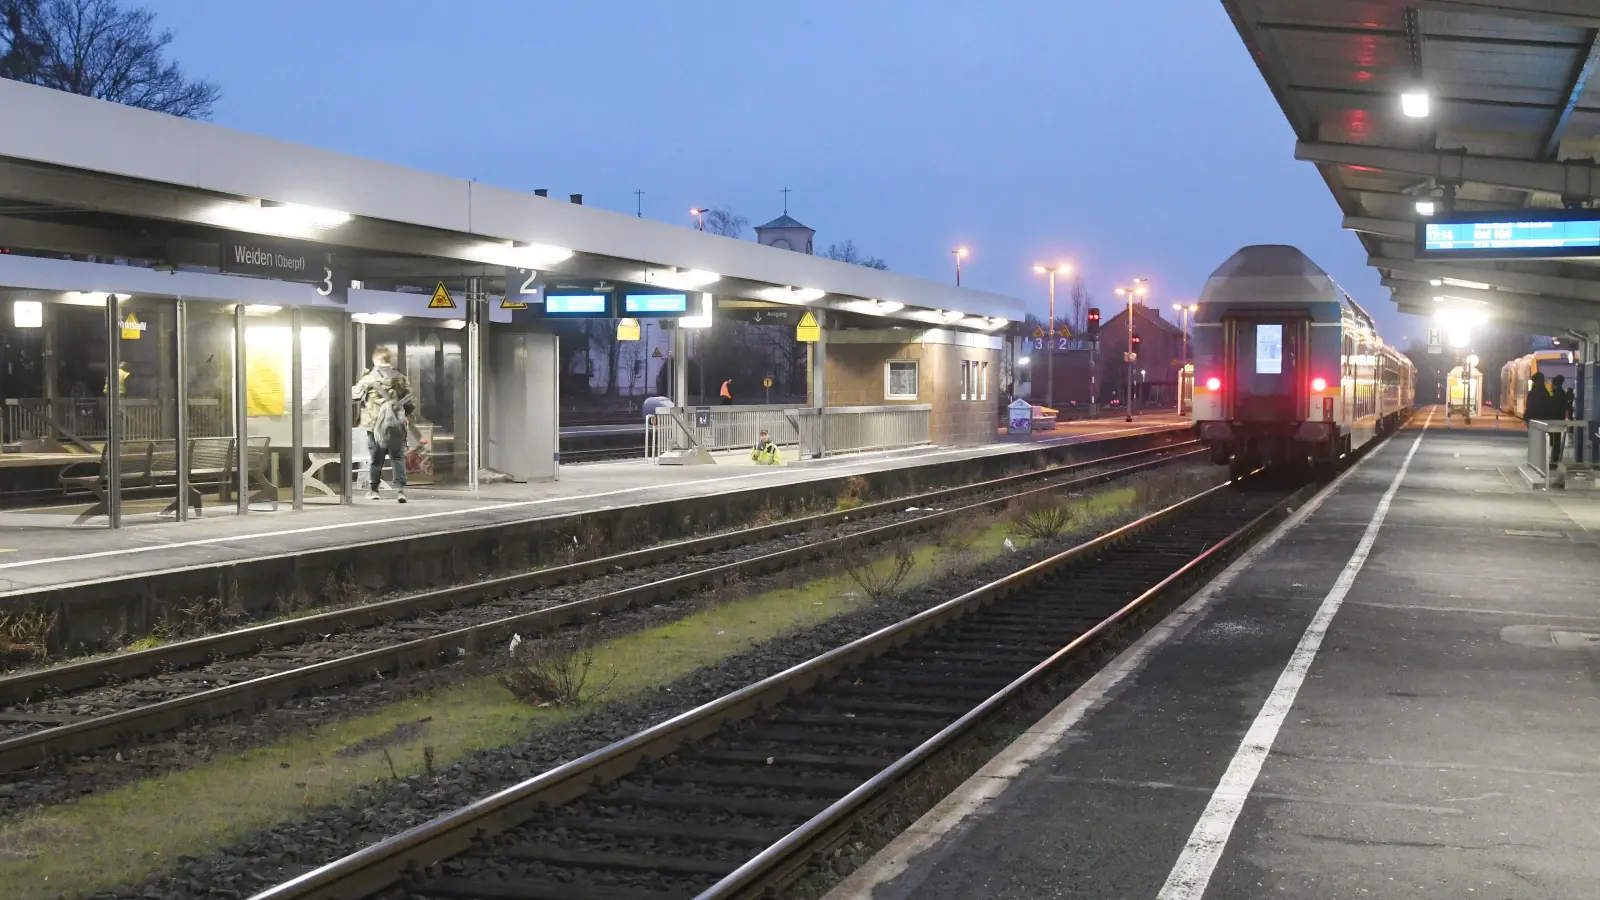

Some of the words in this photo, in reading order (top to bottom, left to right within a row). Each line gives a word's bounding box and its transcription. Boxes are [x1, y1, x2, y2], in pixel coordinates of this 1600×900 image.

[234, 245, 272, 266] Weiden
[274, 254, 305, 271] (Oberpf)
[316, 267, 333, 296] 3
[519, 268, 537, 294] 2
[1035, 337, 1043, 349] 3
[1058, 337, 1067, 350] 2
